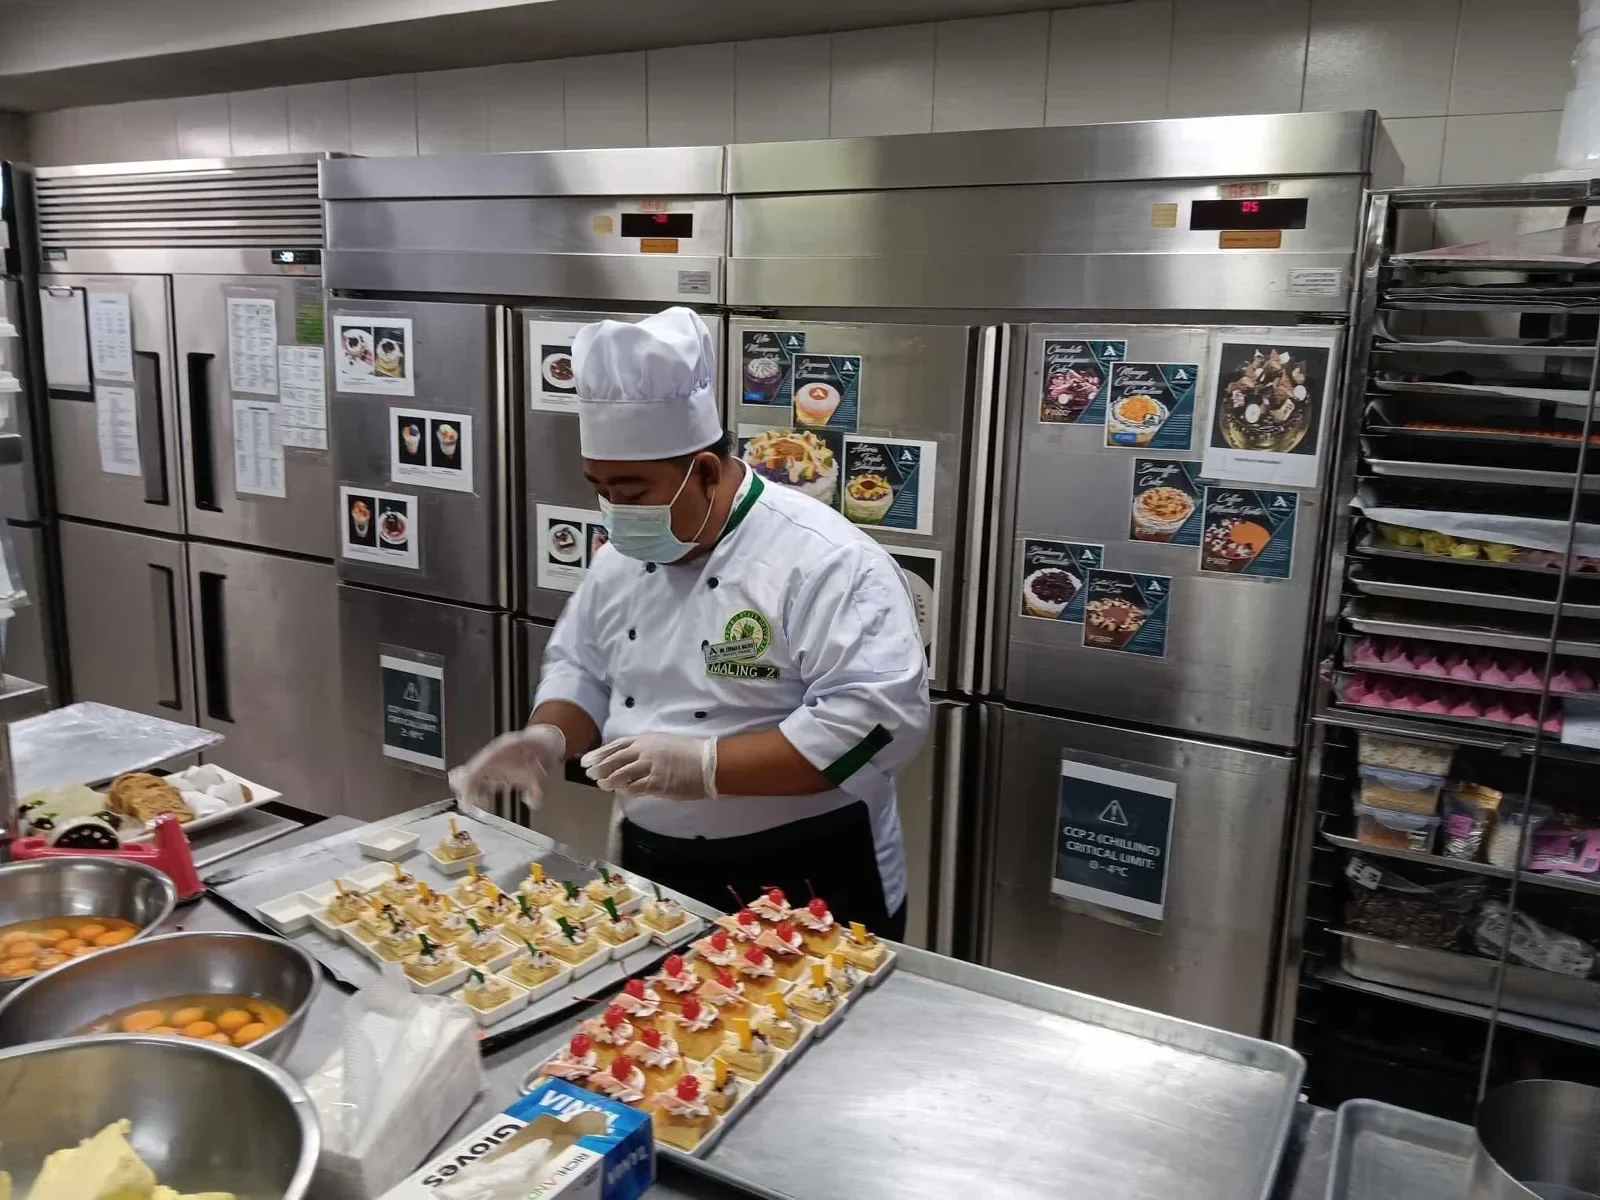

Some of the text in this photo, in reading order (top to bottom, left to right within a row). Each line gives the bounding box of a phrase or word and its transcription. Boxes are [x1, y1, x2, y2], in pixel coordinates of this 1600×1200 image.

[1063, 826, 1160, 857] CCP 2 (CHILLING)
[1066, 841, 1118, 860] CRITICAL
[422, 1124, 523, 1187] Gloves
